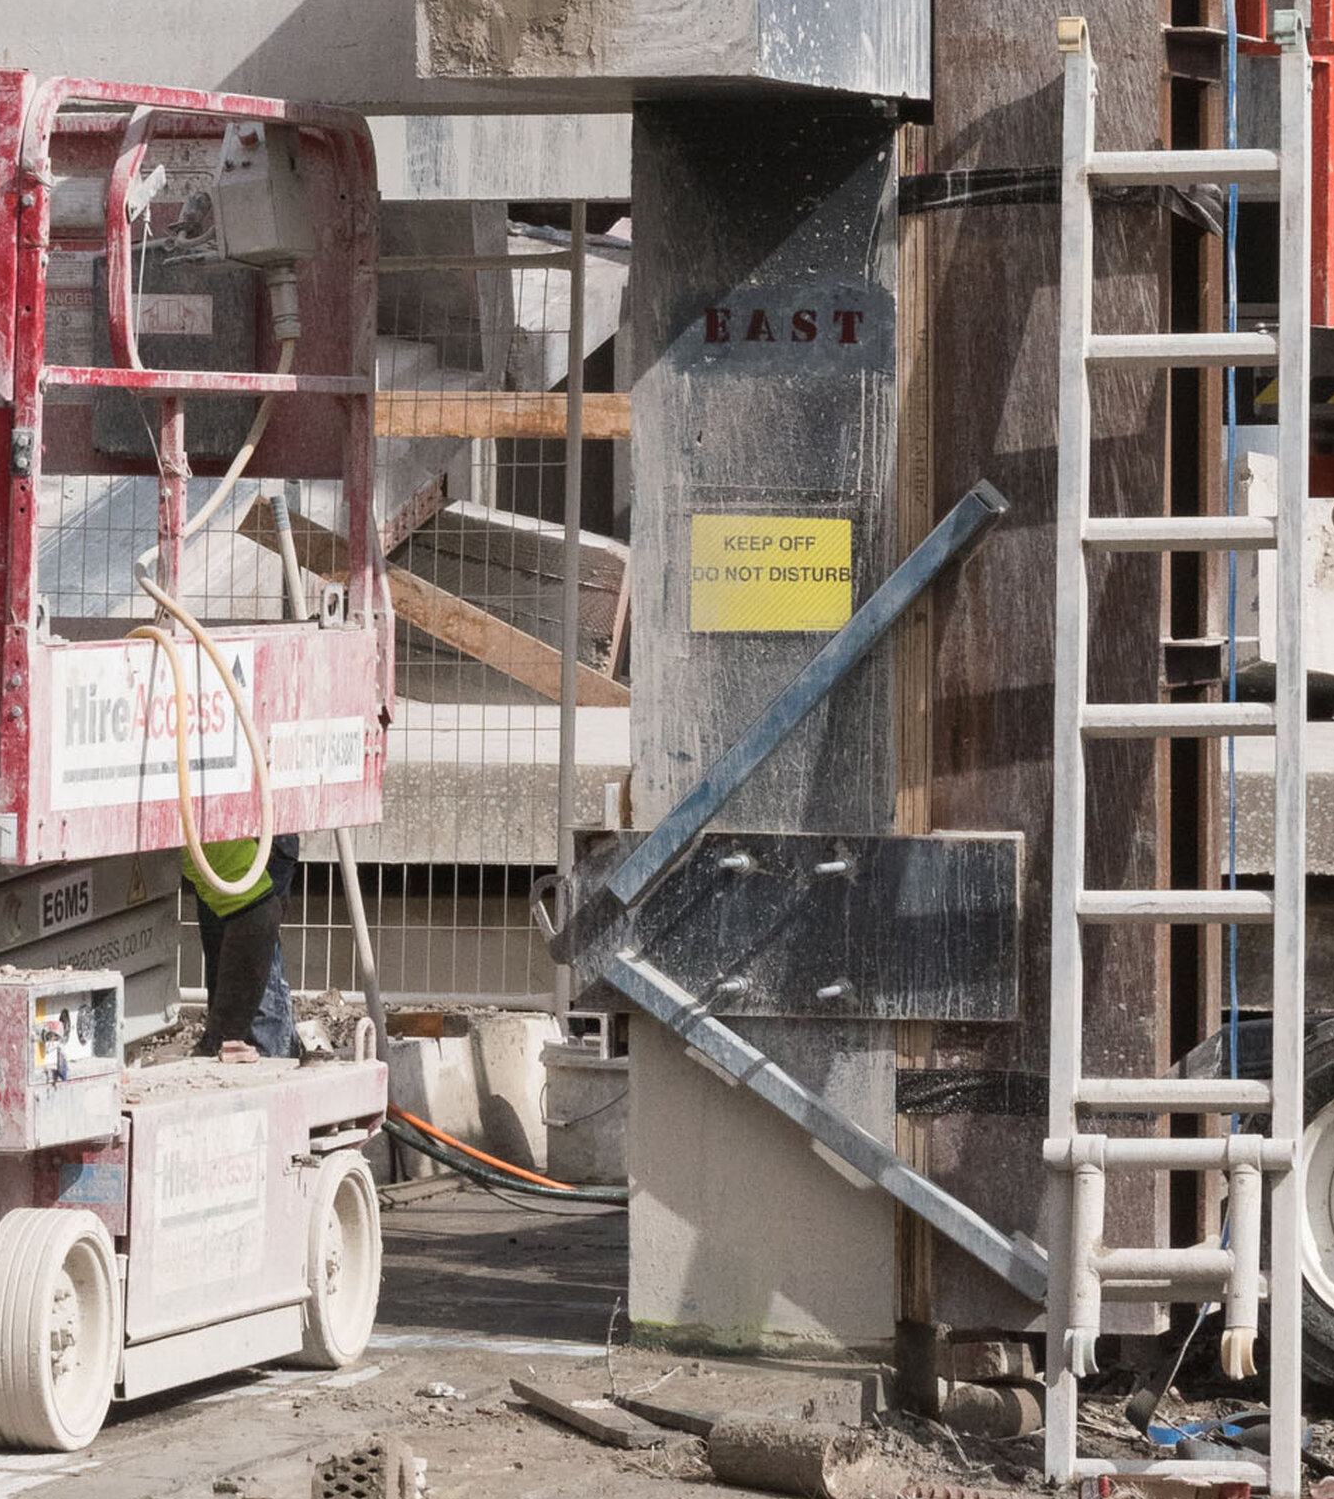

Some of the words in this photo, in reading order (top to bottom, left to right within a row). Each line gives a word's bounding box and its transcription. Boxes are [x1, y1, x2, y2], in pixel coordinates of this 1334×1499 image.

[45, 291, 92, 305] ANGER
[704, 308, 864, 344] EAST
[723, 536, 773, 551] KEEP
[779, 536, 816, 551] OFF
[693, 566, 719, 581] DO
[725, 567, 764, 581] NOT
[769, 567, 851, 582] DISTURB
[43, 880, 88, 927] E6M5
